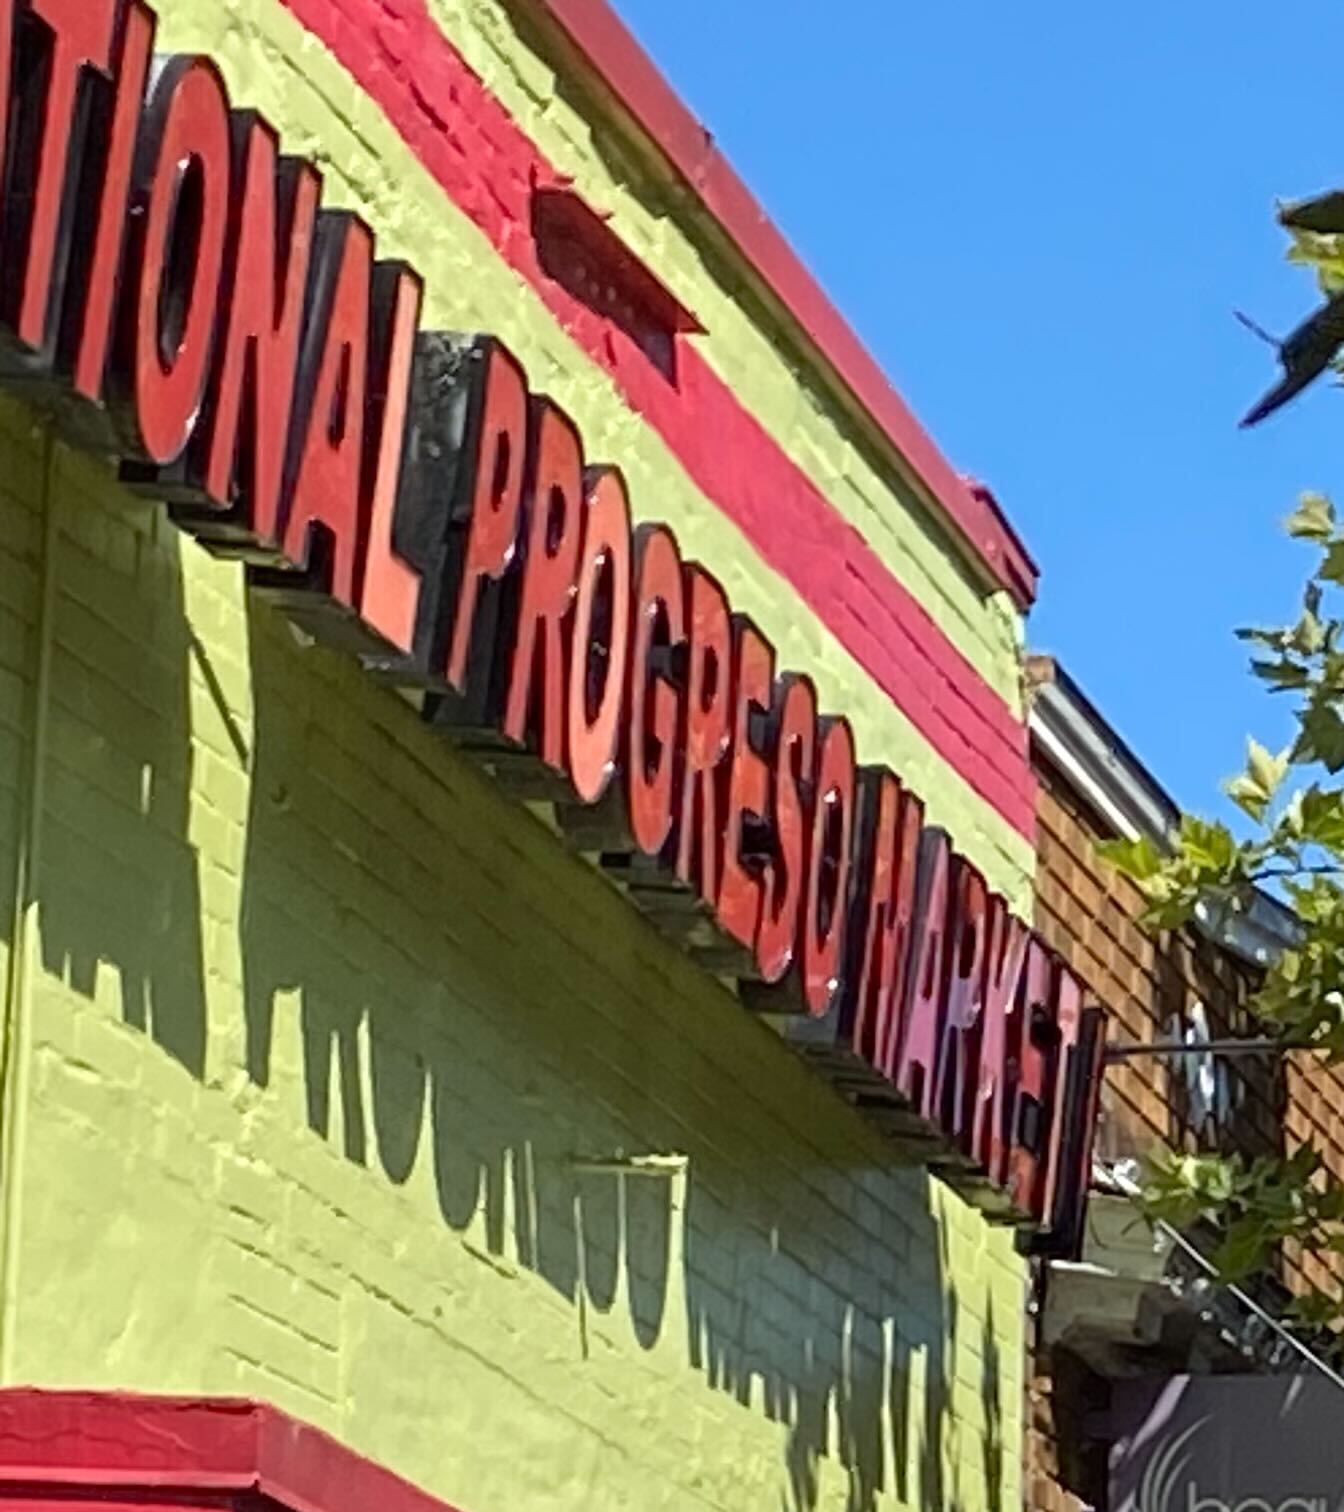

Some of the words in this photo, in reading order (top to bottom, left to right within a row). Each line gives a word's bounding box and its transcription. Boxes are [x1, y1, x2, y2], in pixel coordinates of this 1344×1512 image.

[0, 0, 422, 656] TIONAL
[446, 336, 856, 1018] PROGRESO
[853, 772, 1083, 1232] MARKET
